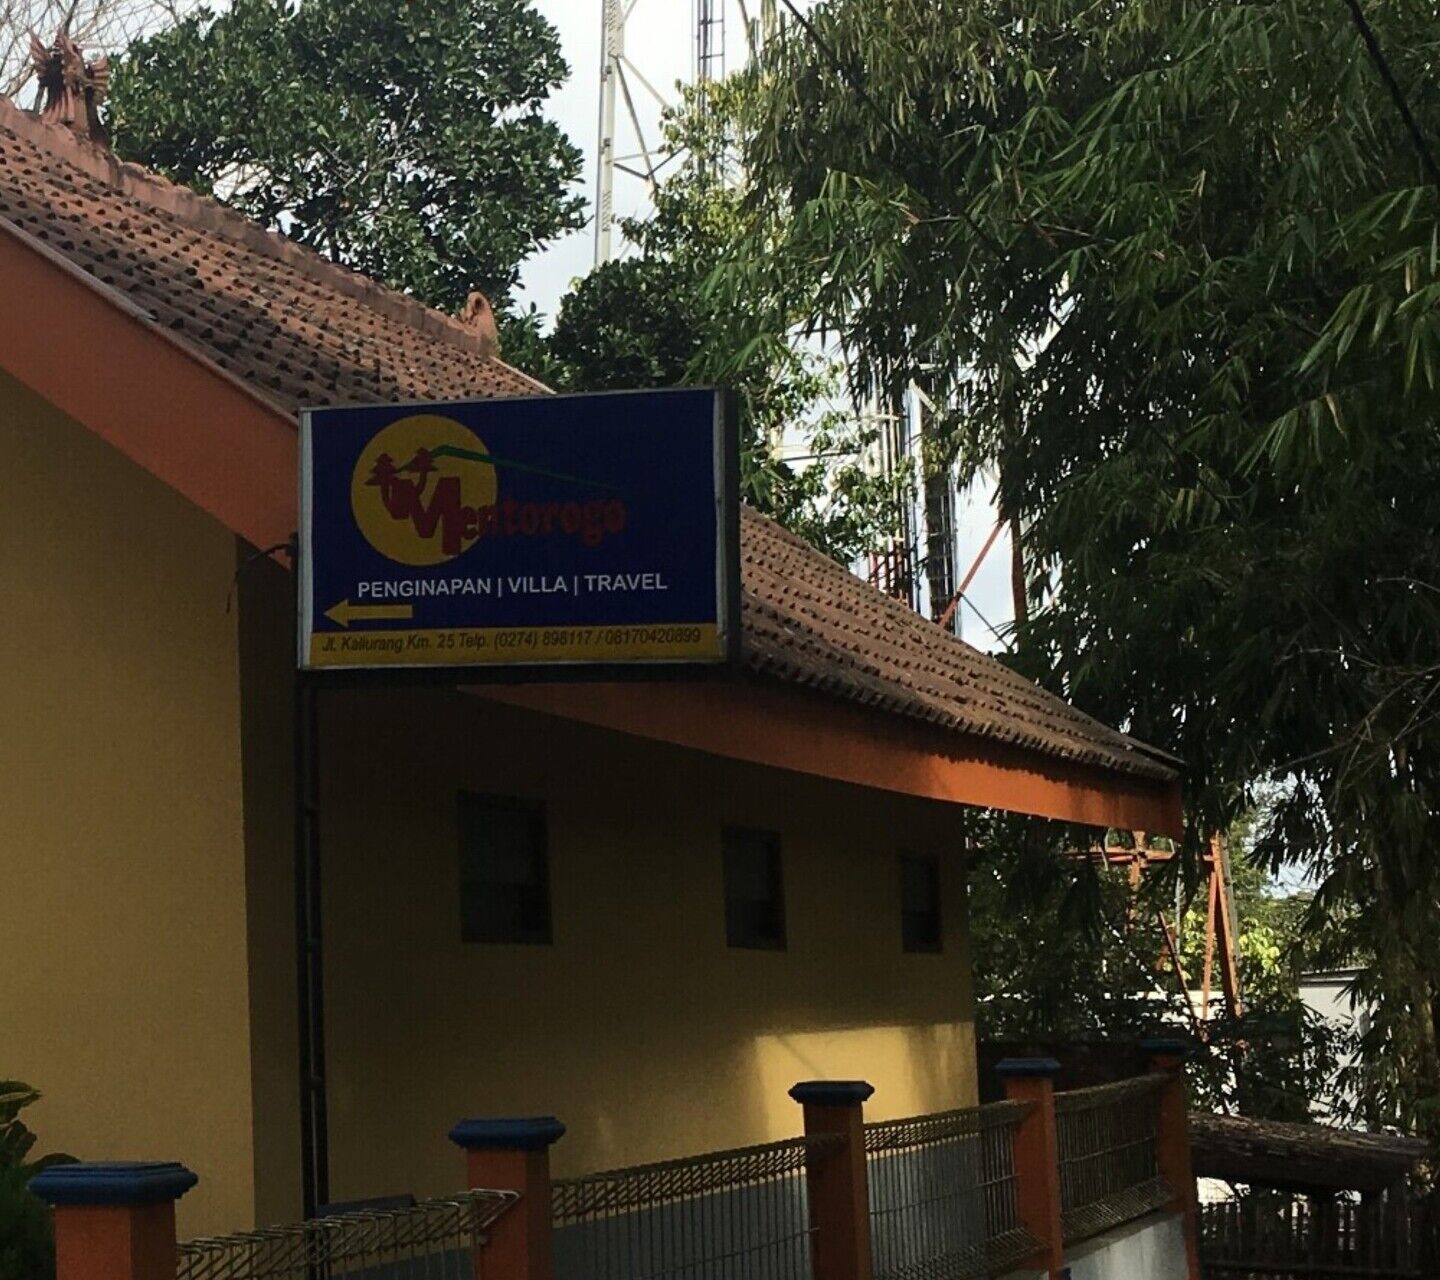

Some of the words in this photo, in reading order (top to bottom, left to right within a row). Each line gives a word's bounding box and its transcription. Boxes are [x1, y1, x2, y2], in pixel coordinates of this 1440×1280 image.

[365, 448, 625, 556] Mentorogo
[358, 578, 491, 597] PENGINAPAN
[508, 575, 567, 594] VILLA
[584, 574, 667, 592] TRAVEL
[321, 638, 337, 652] Jl.
[340, 635, 403, 653] Kaliurang
[405, 634, 431, 649] Km.
[436, 634, 456, 649] 25
[459, 632, 489, 650] Telp.
[493, 630, 538, 649] (0274)
[542, 629, 593, 646] 898117
